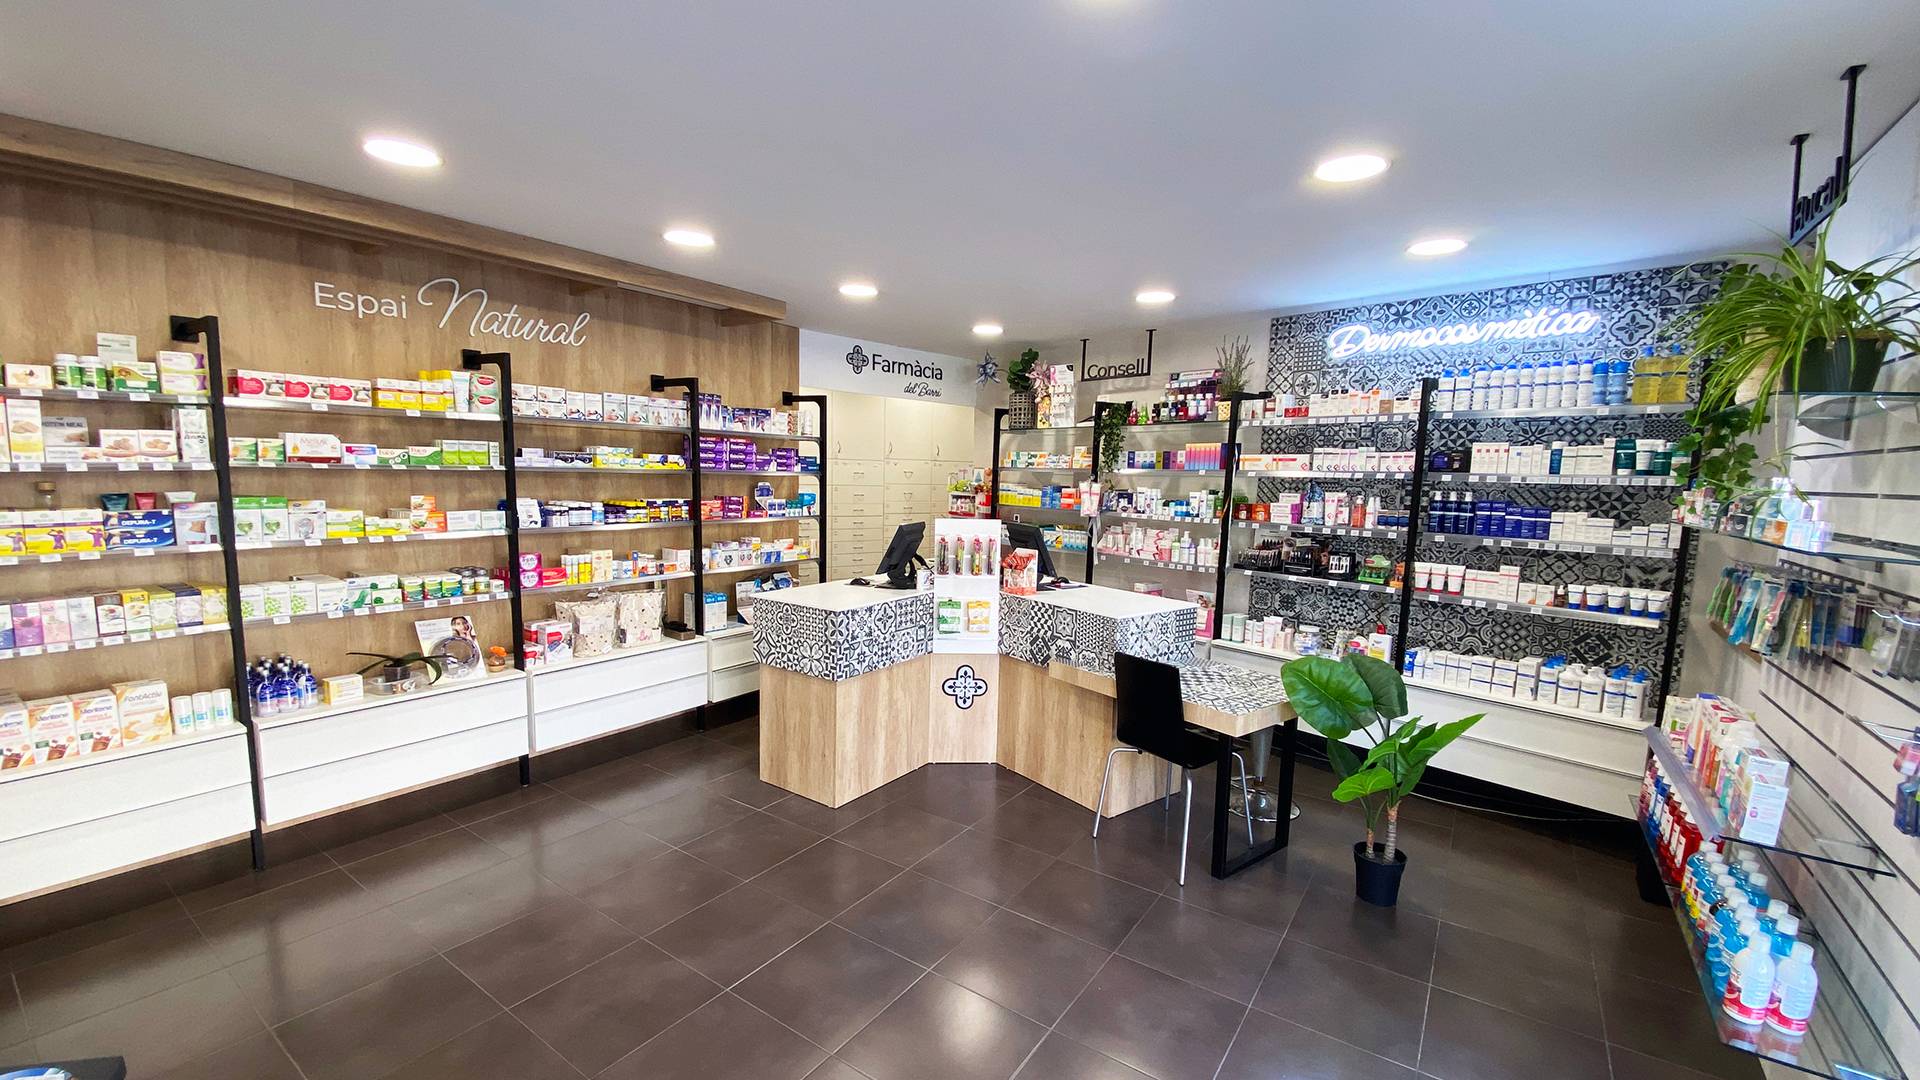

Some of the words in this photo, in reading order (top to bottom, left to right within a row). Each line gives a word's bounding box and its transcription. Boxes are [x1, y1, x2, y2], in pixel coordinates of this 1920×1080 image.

[314, 281, 408, 319] Espai
[417, 277, 591, 346] Natural
[1328, 307, 1601, 358] Dermocosmètica
[872, 353, 943, 380] Farmàcia
[1087, 358, 1144, 378] Consell
[903, 381, 919, 394] del
